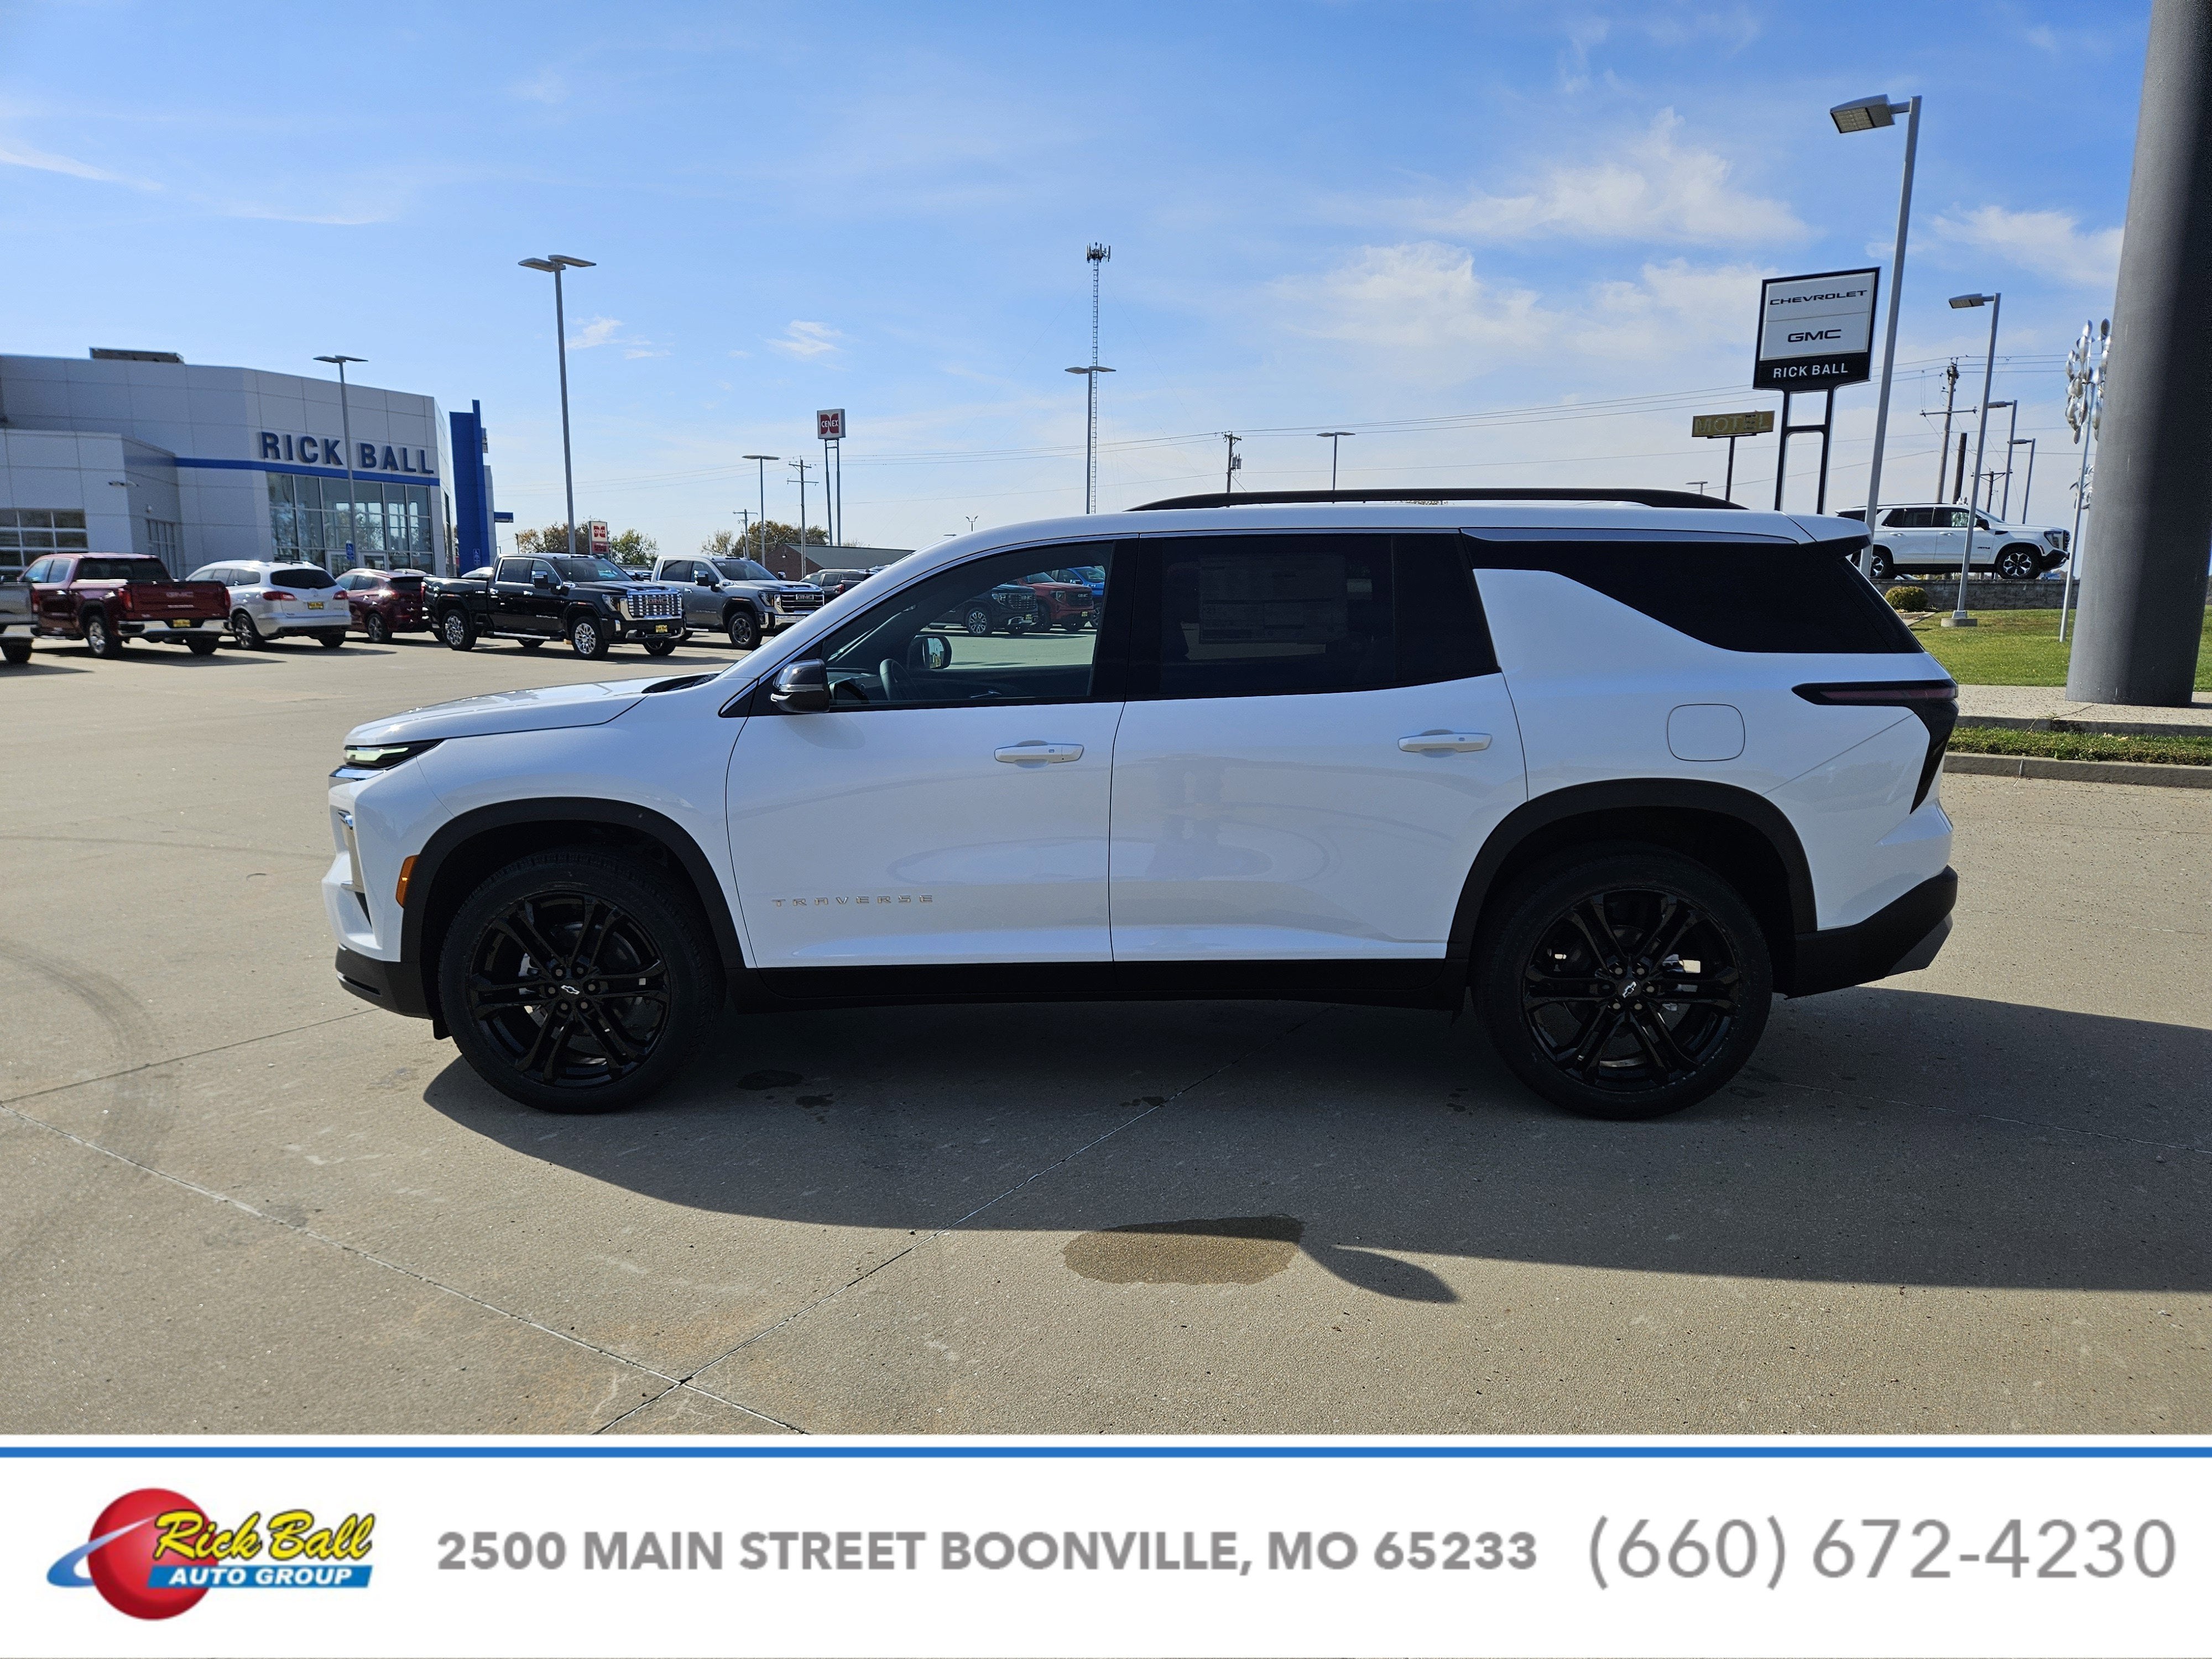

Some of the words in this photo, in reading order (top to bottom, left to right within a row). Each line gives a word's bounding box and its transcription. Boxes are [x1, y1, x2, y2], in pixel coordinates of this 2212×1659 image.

[1770, 290, 1867, 305] CHEVROLET
[1787, 328, 1841, 343] GMC
[1773, 366, 1808, 378] RICK
[1812, 363, 1848, 375] BALL
[821, 419, 838, 427] CENEX
[1694, 414, 1770, 434] MOTEL
[258, 431, 343, 466] RICK
[358, 442, 434, 474] BALL
[773, 895, 933, 907] TRAVERSE
